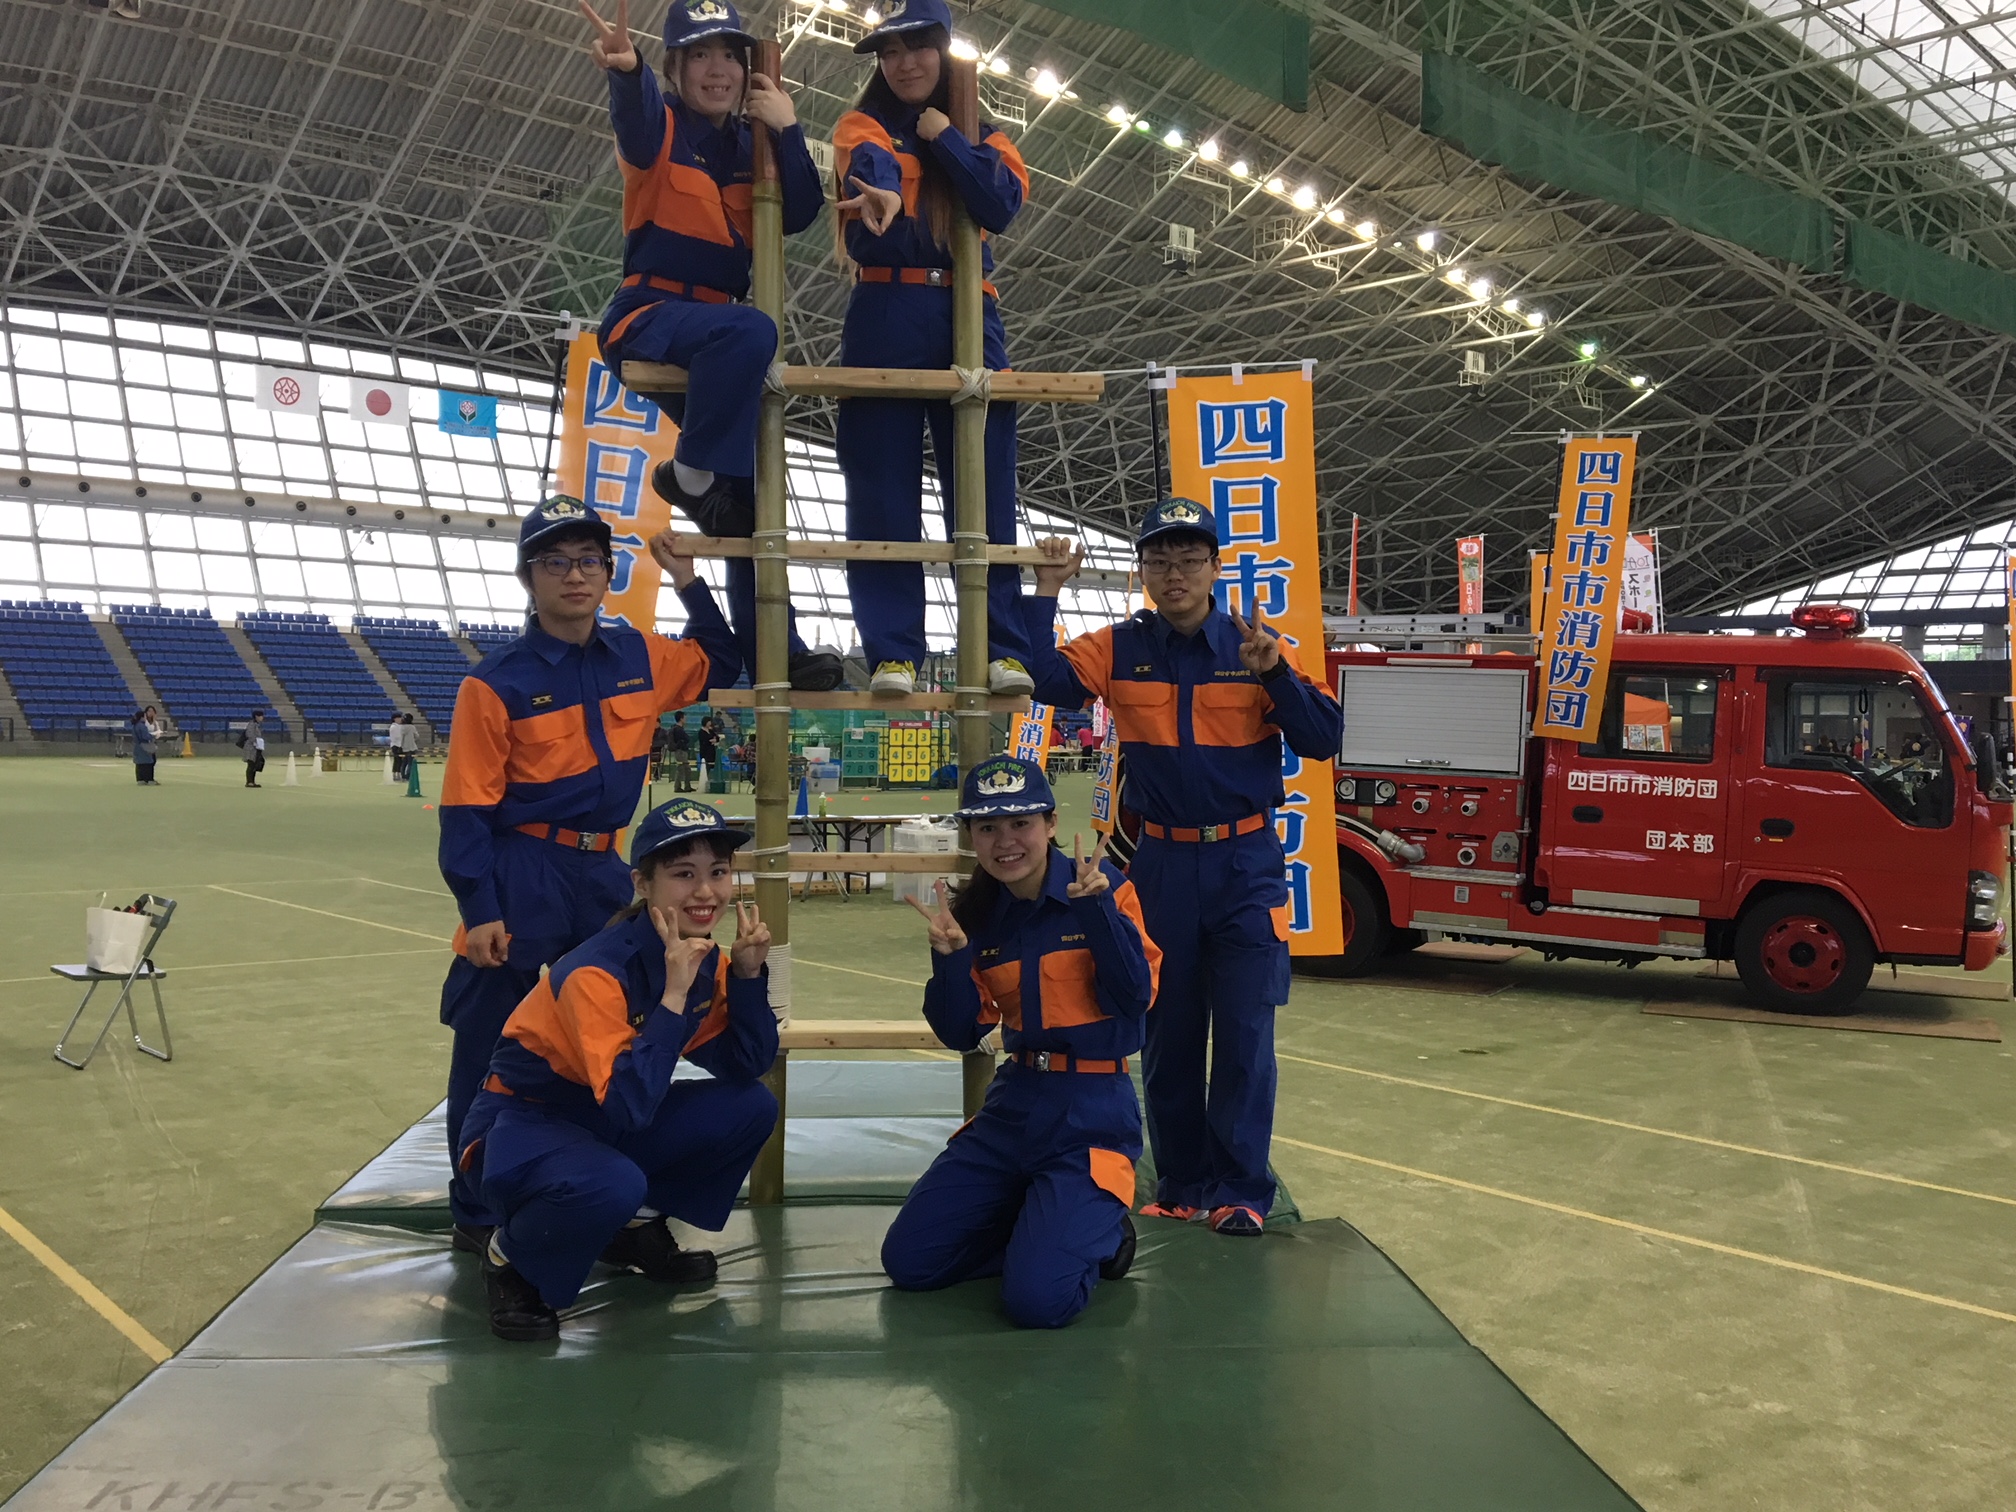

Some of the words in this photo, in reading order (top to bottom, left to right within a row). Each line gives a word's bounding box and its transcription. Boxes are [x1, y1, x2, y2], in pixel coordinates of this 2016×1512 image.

[1543, 449, 1624, 730] 四日市市消防団
[1567, 771, 1718, 799] 四日市市消防団
[1645, 829, 1714, 854] 団本部
